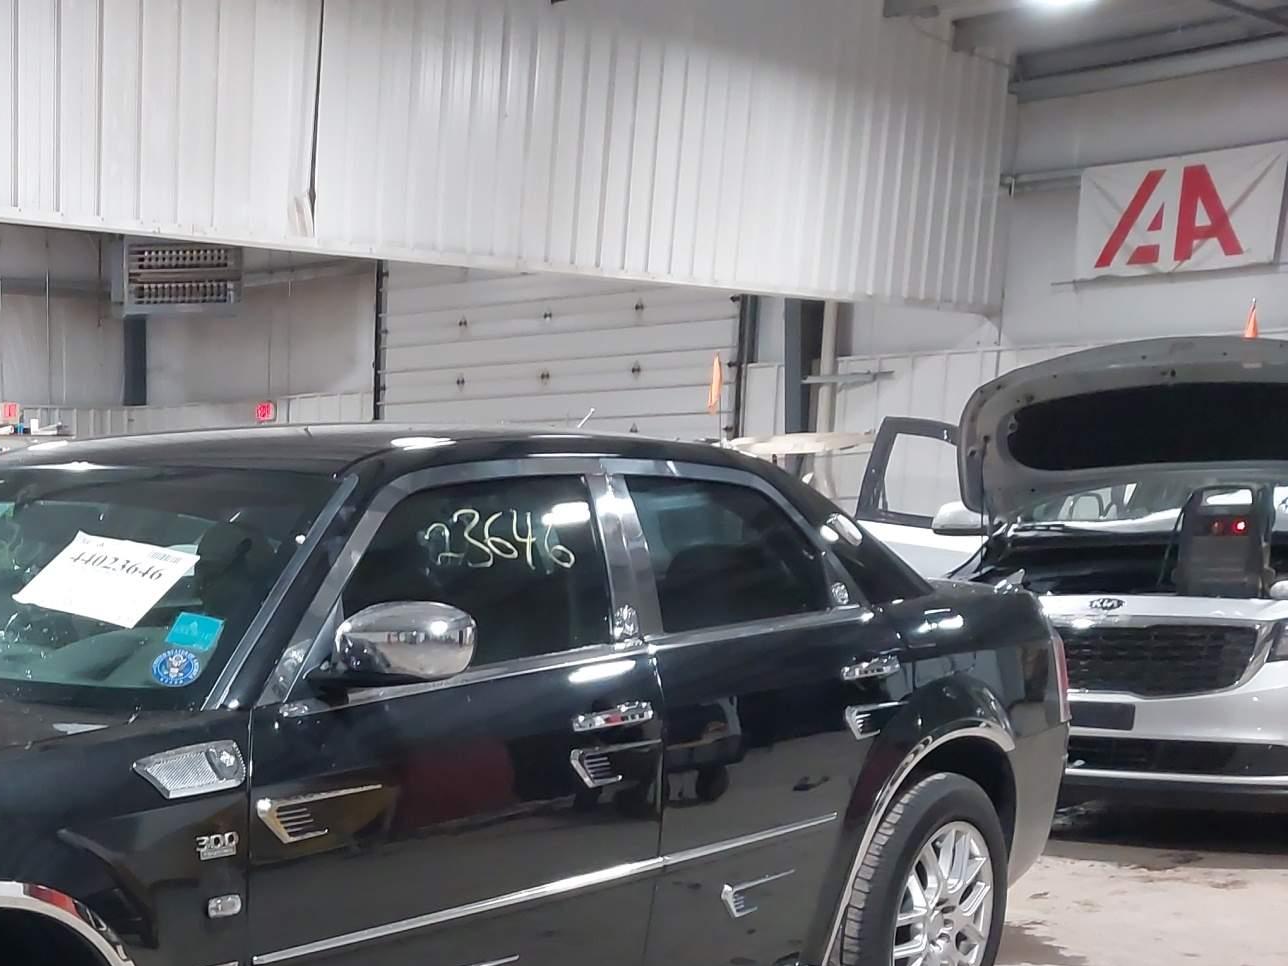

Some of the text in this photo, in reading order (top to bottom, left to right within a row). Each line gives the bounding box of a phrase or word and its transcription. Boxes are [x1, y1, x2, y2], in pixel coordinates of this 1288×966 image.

[423, 507, 576, 570] 23646
[70, 550, 165, 581] 44023646
[195, 831, 240, 852] 300
